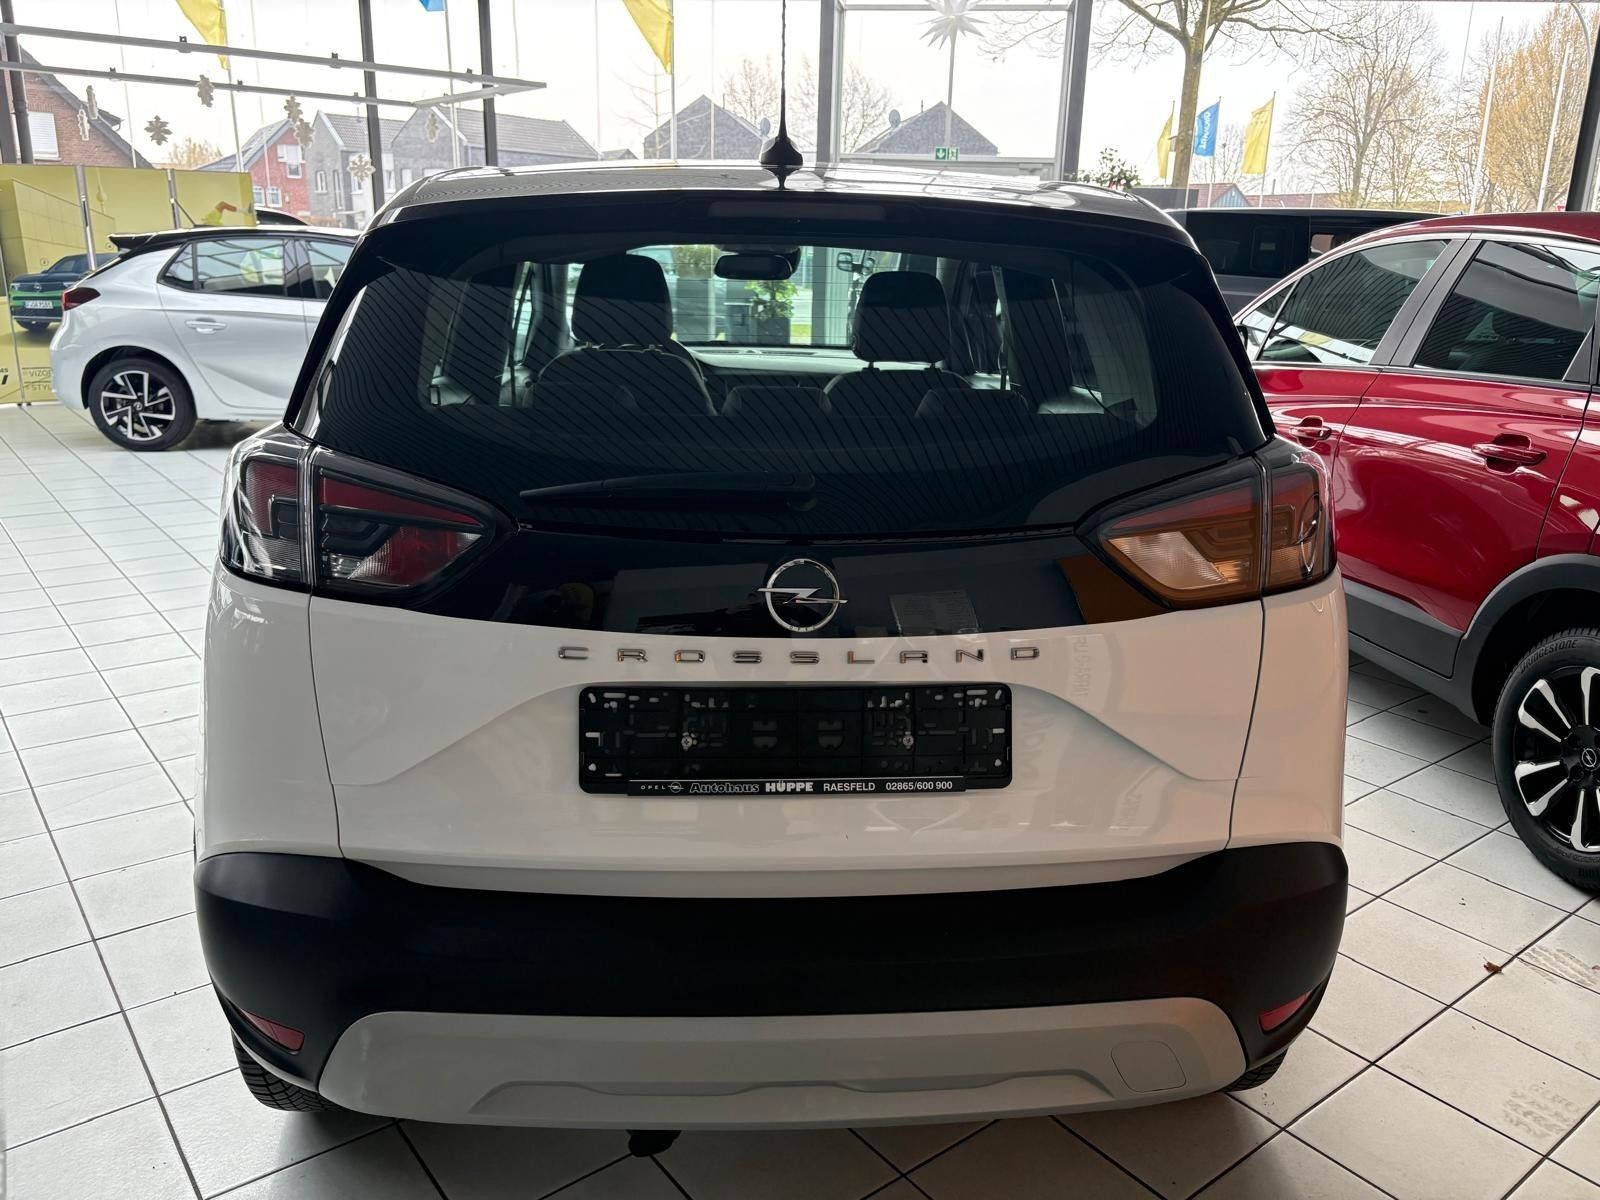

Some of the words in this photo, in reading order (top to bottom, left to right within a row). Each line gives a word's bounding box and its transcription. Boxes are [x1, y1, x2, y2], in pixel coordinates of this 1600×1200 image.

[558, 645, 1041, 664] CROSSLAND
[689, 782, 760, 793] Autohaus
[765, 780, 814, 792] HÜPPE
[823, 782, 876, 792] RAESFELD
[885, 781, 934, 791] 02865/600
[935, 781, 953, 790] 900
